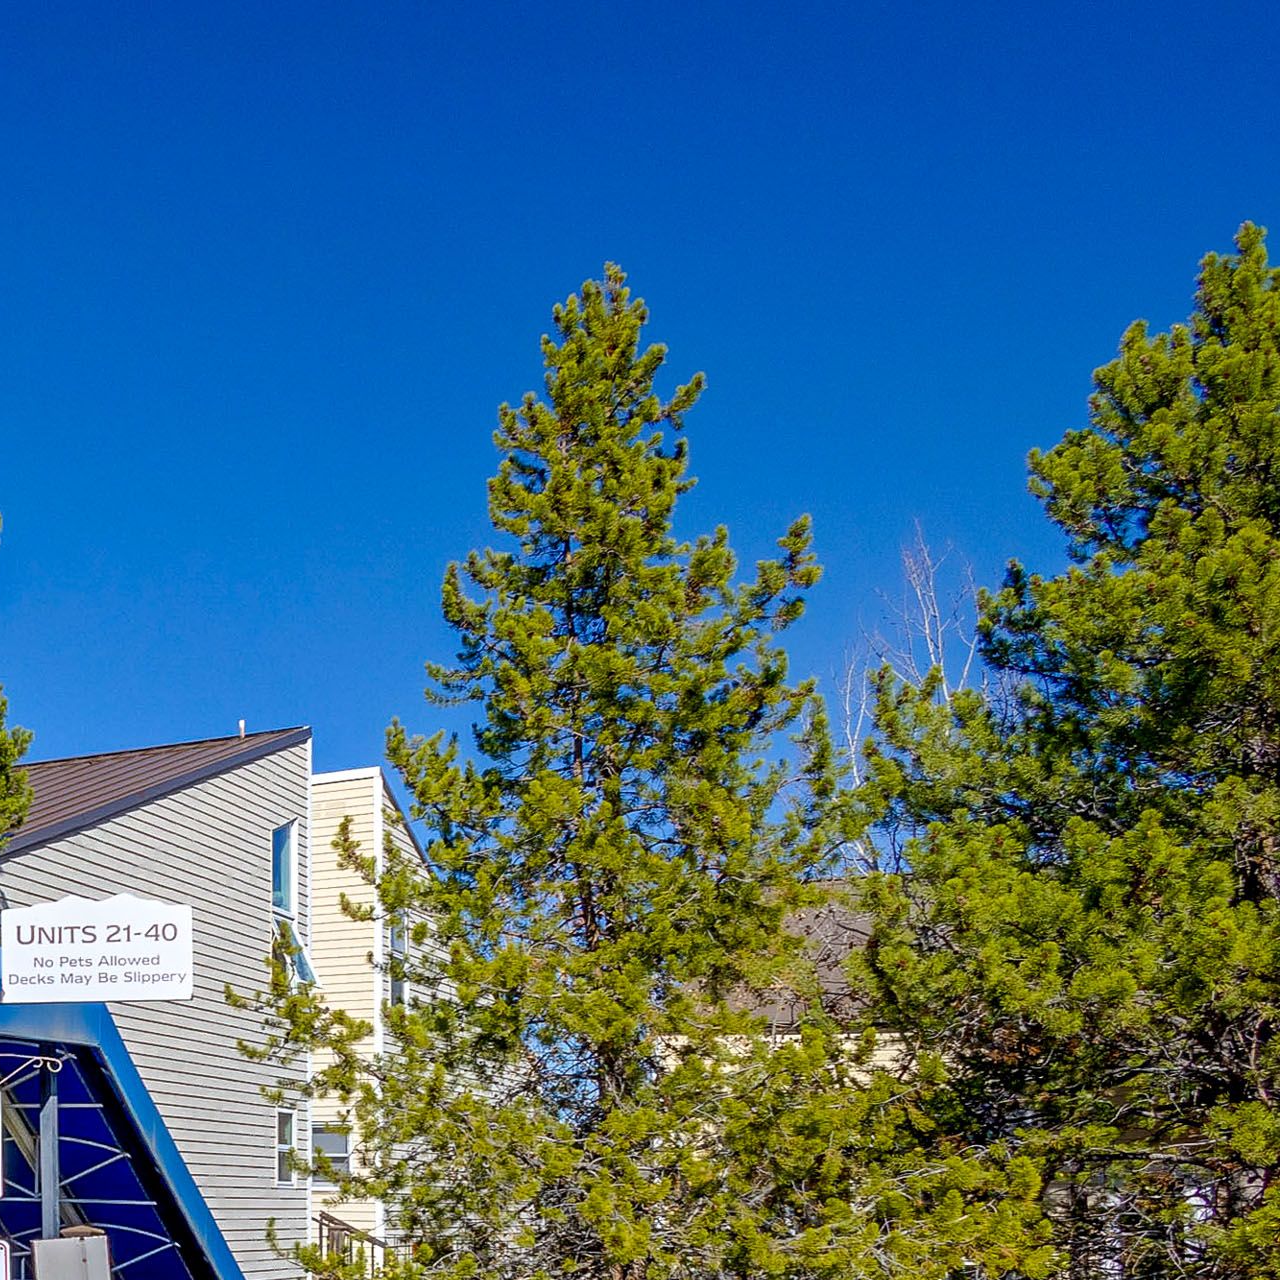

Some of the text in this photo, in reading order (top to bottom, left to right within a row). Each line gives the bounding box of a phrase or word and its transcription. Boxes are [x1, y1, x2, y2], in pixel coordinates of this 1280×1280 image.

[16, 923, 178, 945] UNITS 21-40
[33, 955, 160, 968] No Pets Allowed
[8, 971, 187, 985] Decks May Be Slippery
